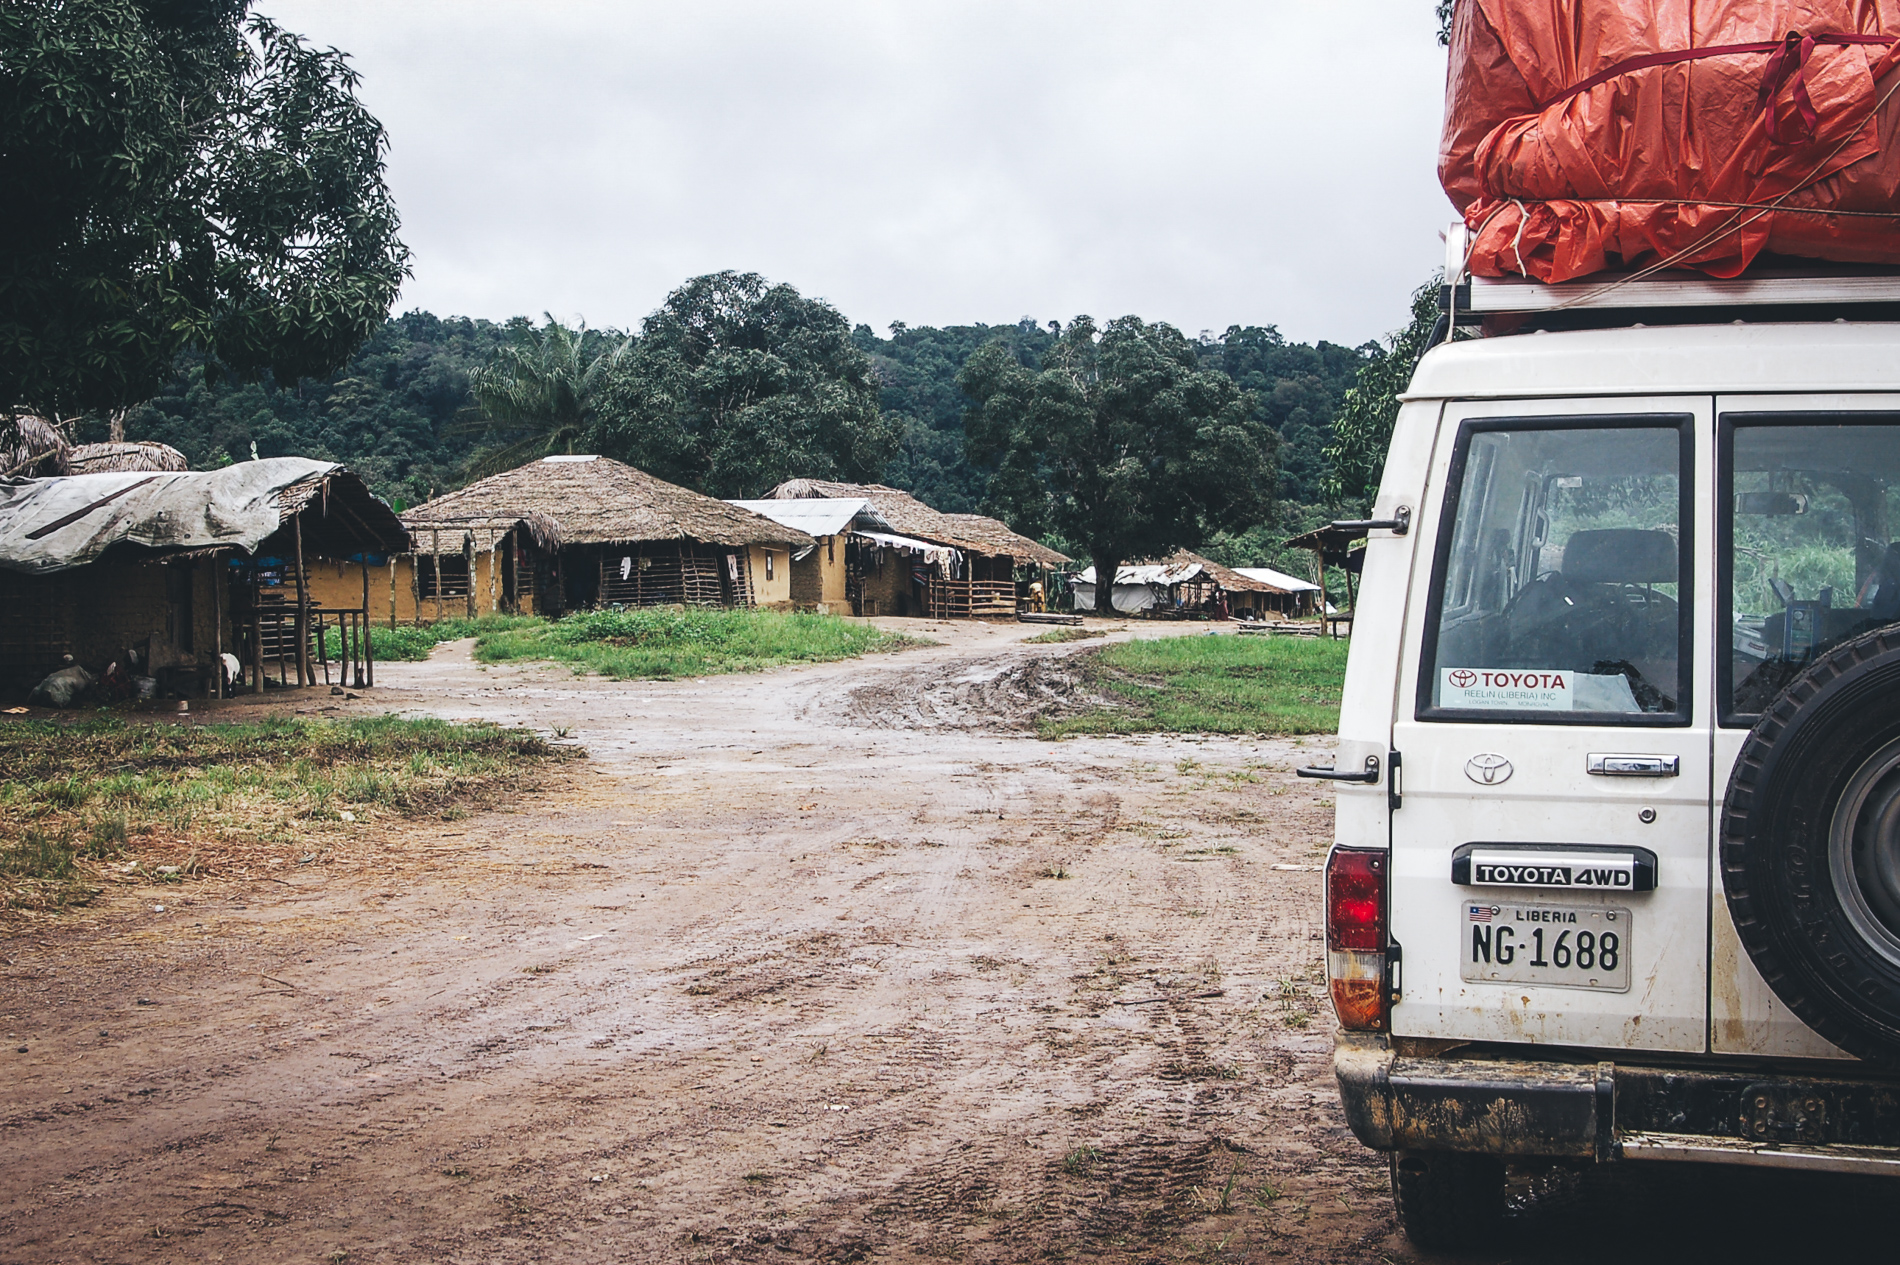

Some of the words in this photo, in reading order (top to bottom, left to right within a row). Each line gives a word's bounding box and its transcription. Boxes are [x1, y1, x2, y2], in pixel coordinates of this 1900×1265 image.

[1481, 672, 1565, 689] TOYOTA
[1464, 690, 1496, 698] REELIN
[1497, 691, 1538, 700] (LIBERIA)
[1540, 692, 1556, 701] INC
[1480, 866, 1567, 884] TOYOTA
[1574, 869, 1631, 886] 4WD
[1516, 910, 1577, 923] LIBERIA
[1472, 924, 1619, 971] NG-1688
